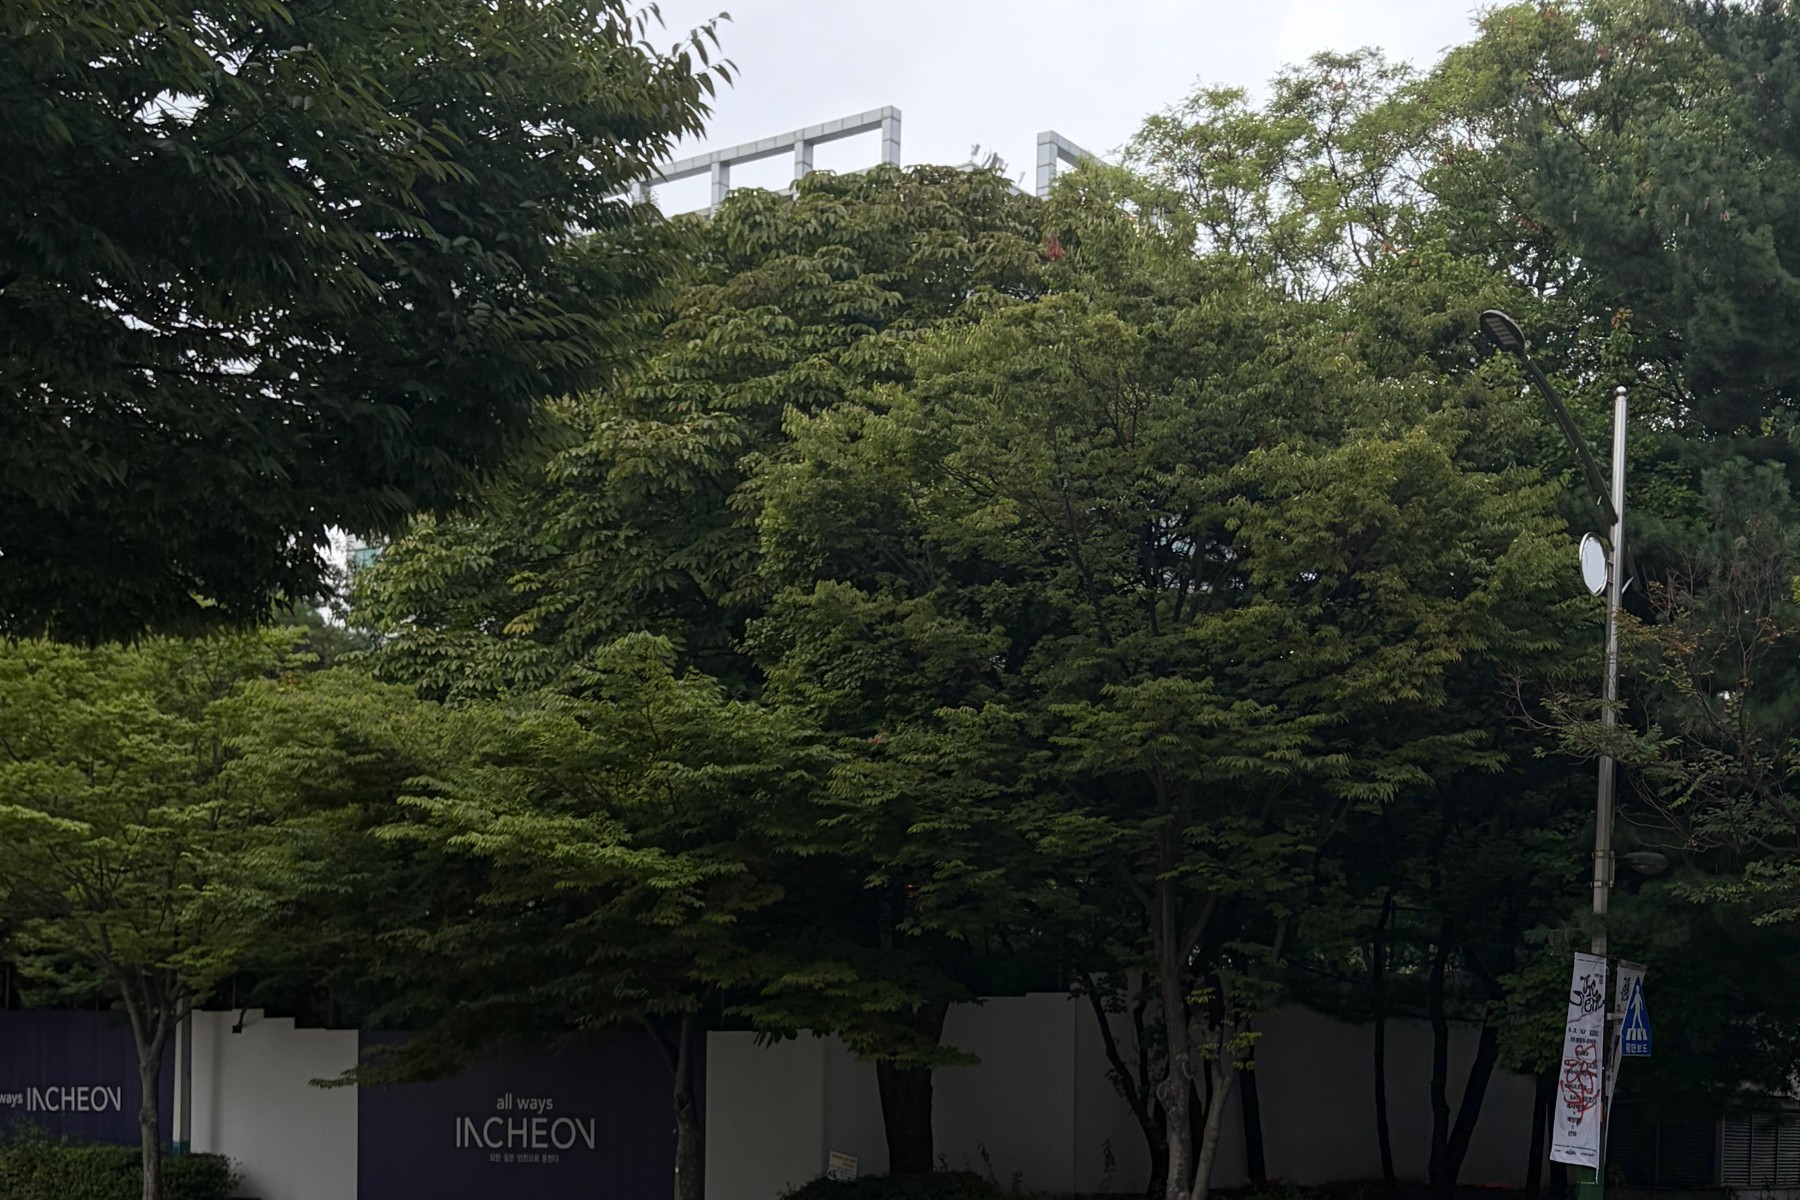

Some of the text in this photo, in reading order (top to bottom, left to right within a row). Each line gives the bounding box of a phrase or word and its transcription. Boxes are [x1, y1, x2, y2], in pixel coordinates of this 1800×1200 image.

[27, 1086, 121, 1112] INCHEON
[496, 1092, 554, 1115] all ways
[456, 1116, 596, 1150] INCHEON
